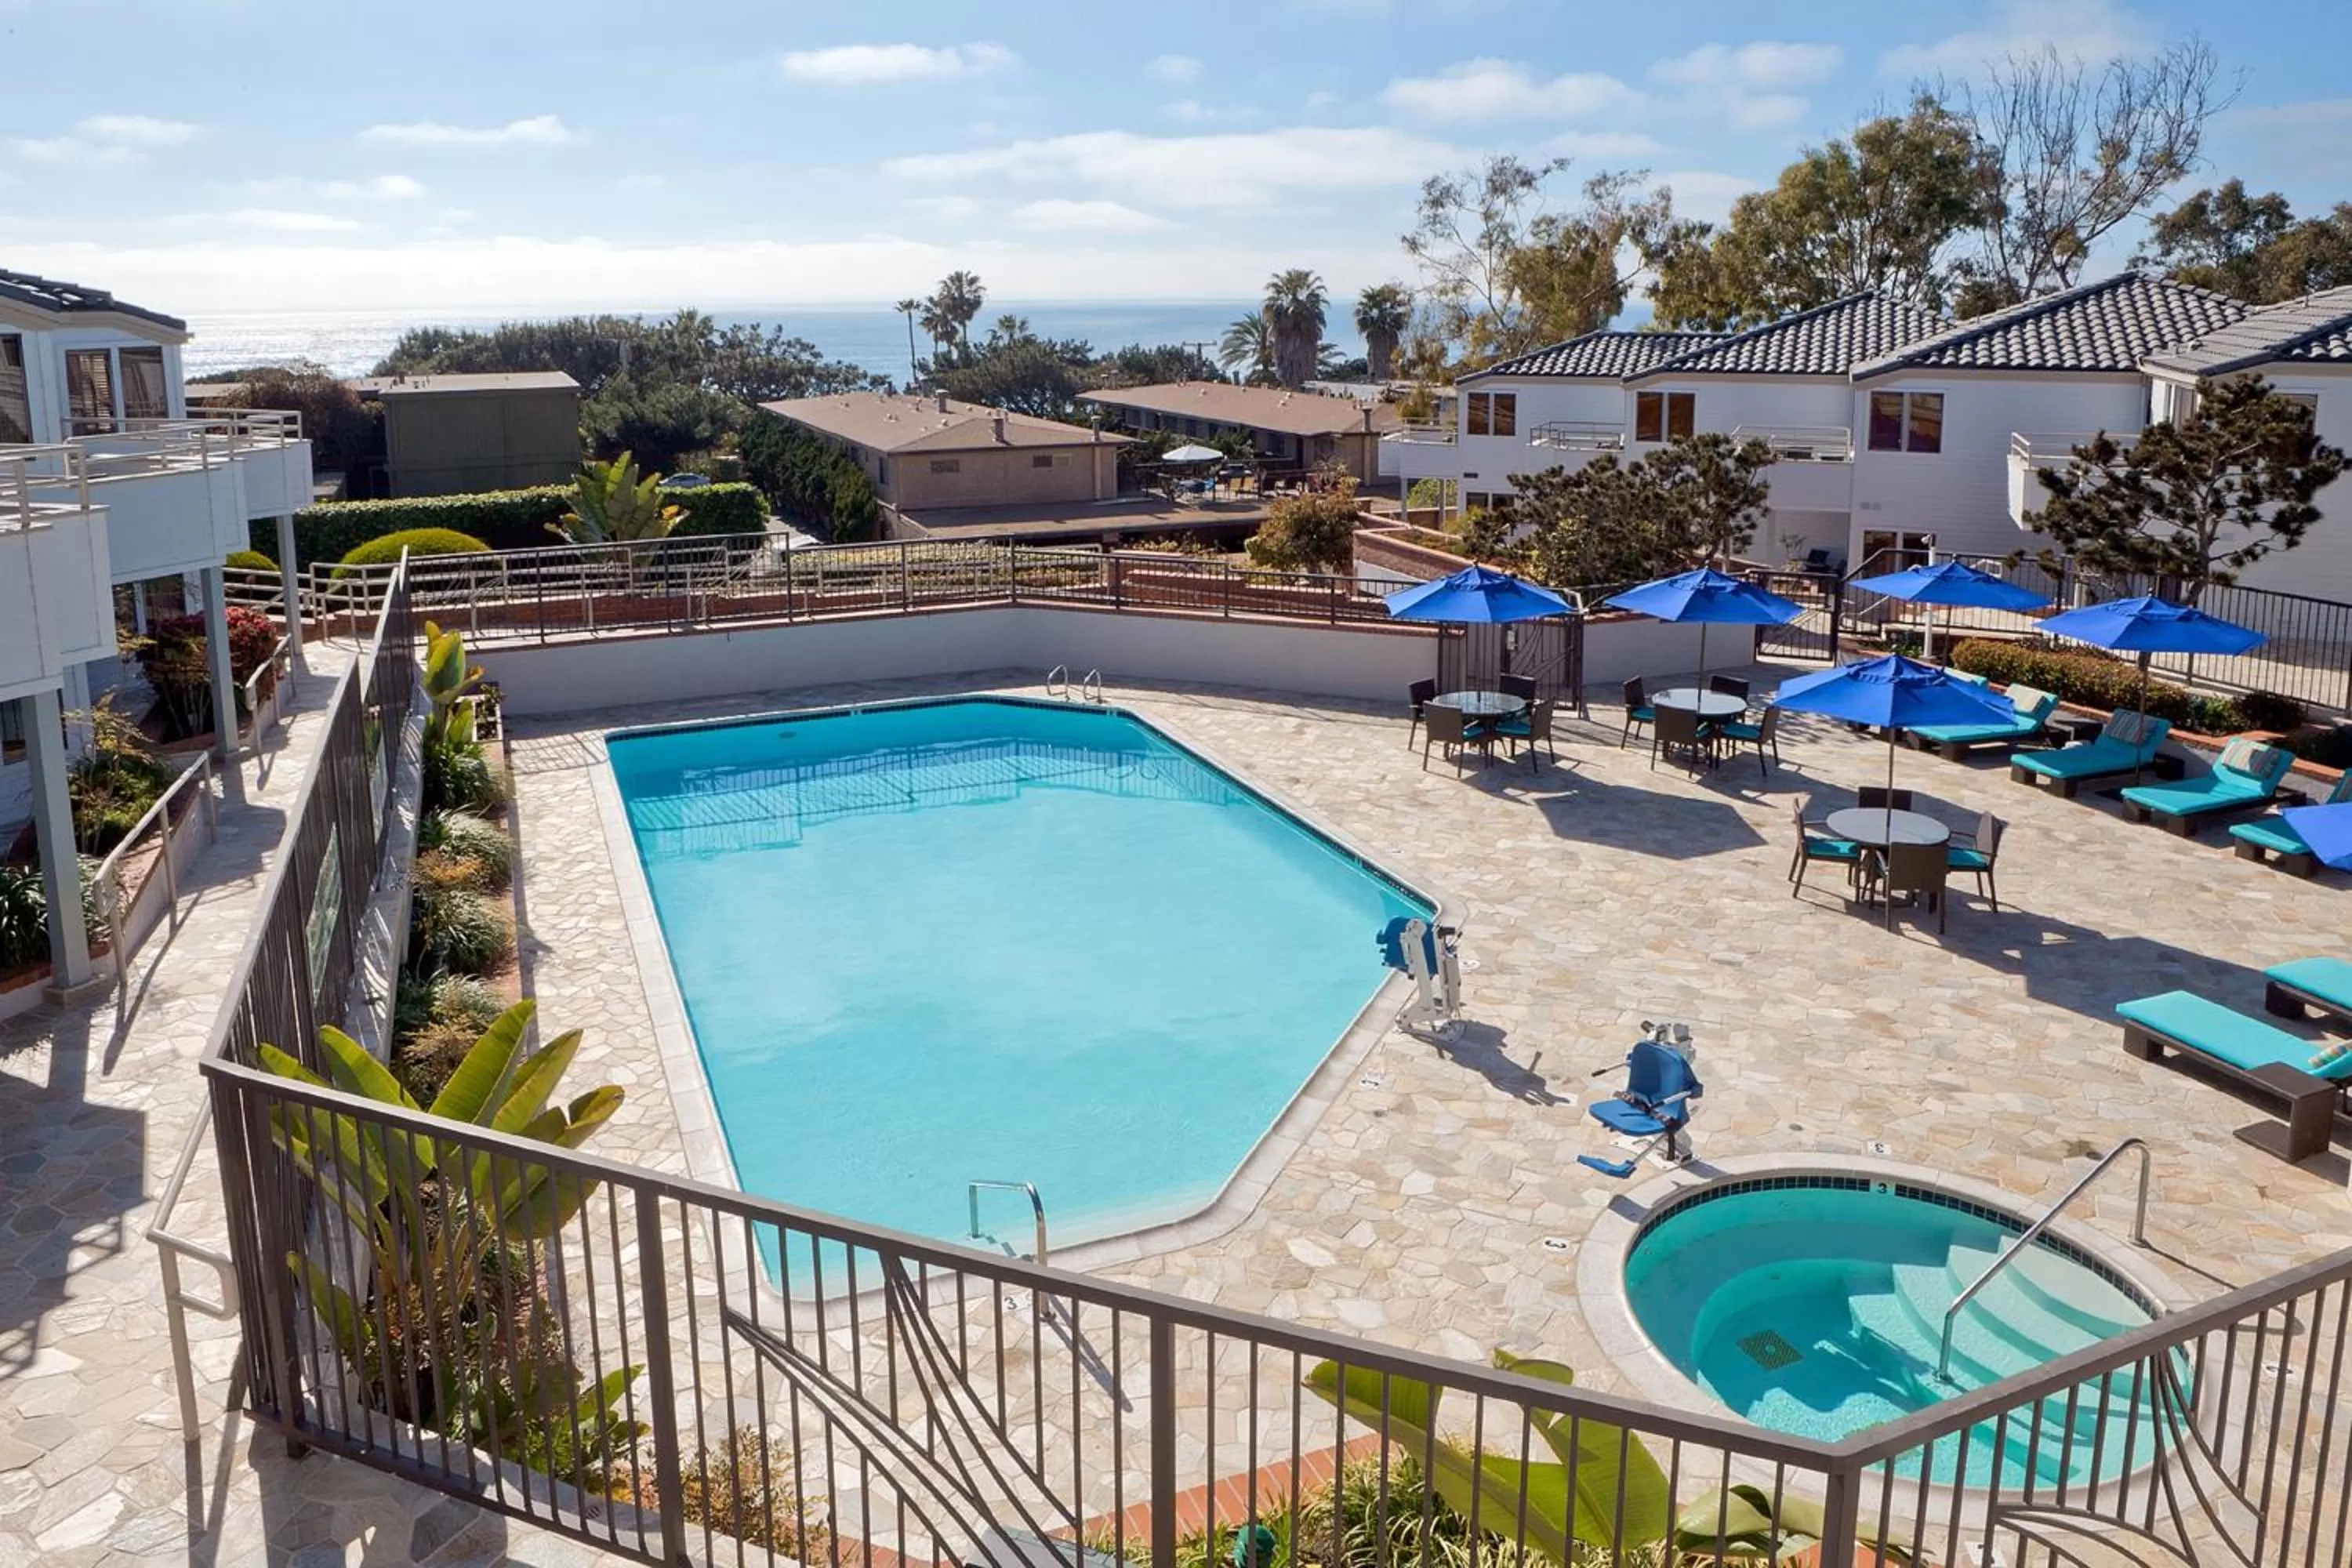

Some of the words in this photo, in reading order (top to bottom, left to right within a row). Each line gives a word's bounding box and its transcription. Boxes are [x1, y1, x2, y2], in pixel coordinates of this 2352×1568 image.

[1875, 1142, 1884, 1153] 3
[1877, 1181, 1888, 1194] 3
[1004, 1296, 1018, 1310] 3
